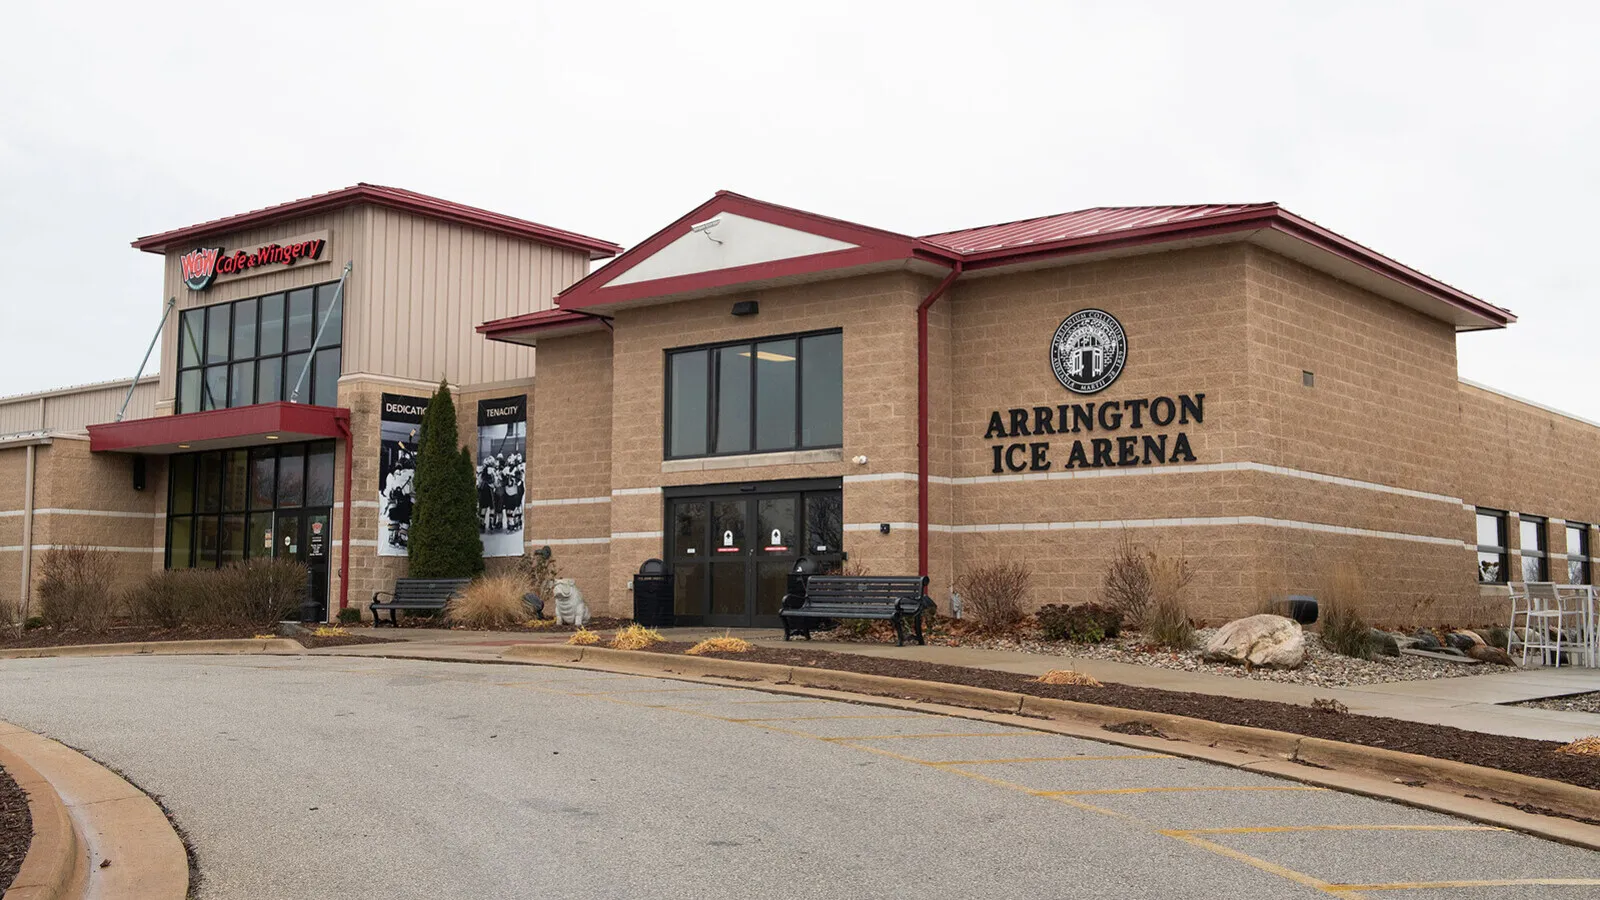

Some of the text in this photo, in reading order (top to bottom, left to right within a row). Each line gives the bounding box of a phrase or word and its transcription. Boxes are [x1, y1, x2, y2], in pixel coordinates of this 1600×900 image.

[215, 250, 246, 273] Cafe
[247, 254, 257, 268] &
[257, 239, 322, 265] Wingery
[1054, 313, 1087, 346] ADRIANIUM
[1088, 312, 1122, 341] COLLEGIUM
[486, 405, 519, 418] TENACITY
[984, 393, 1206, 439] ARRINGTON
[991, 432, 1197, 473] ICE ARENA
